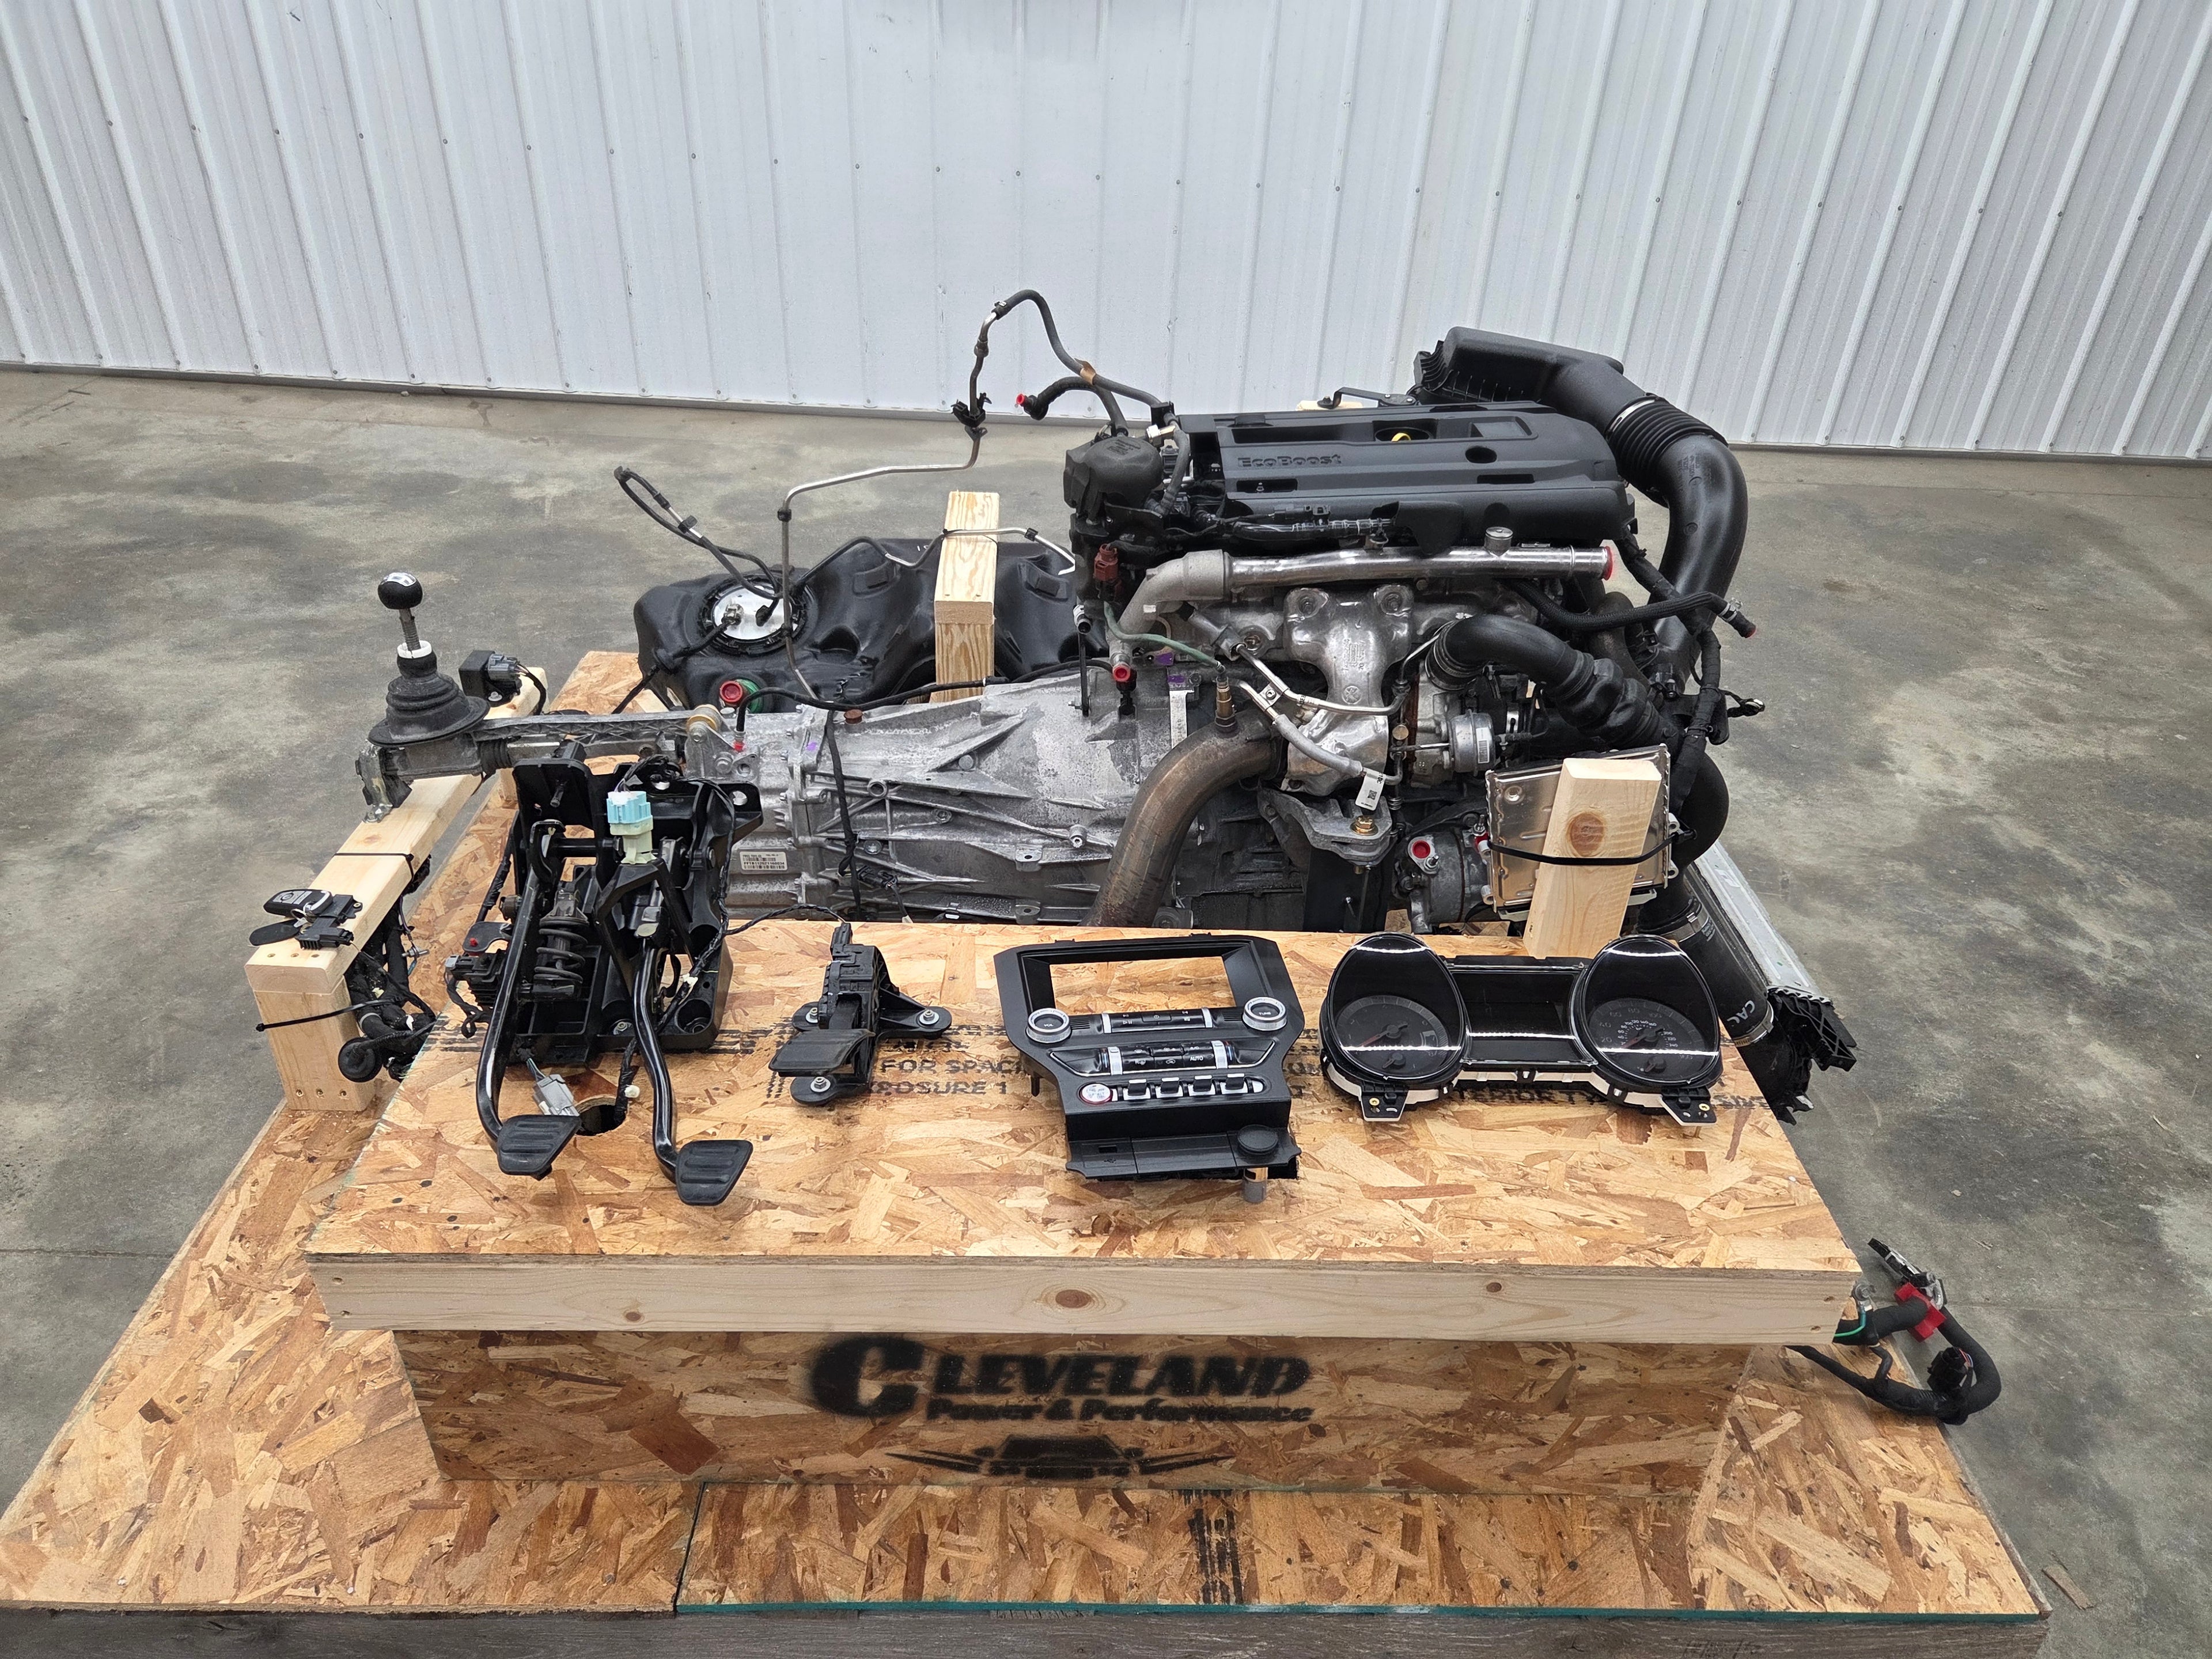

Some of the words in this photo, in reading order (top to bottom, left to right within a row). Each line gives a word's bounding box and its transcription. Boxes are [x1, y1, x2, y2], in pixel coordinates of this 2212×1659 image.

[1237, 453, 1342, 467] EcoBoost
[881, 1059, 937, 1073] FOR
[996, 1081, 1007, 1094] 1
[810, 1334, 1313, 1418] CLEVELAND
[927, 1397, 1044, 1421] Power
[1046, 1397, 1073, 1421] &
[1080, 1397, 1315, 1422] Performance
